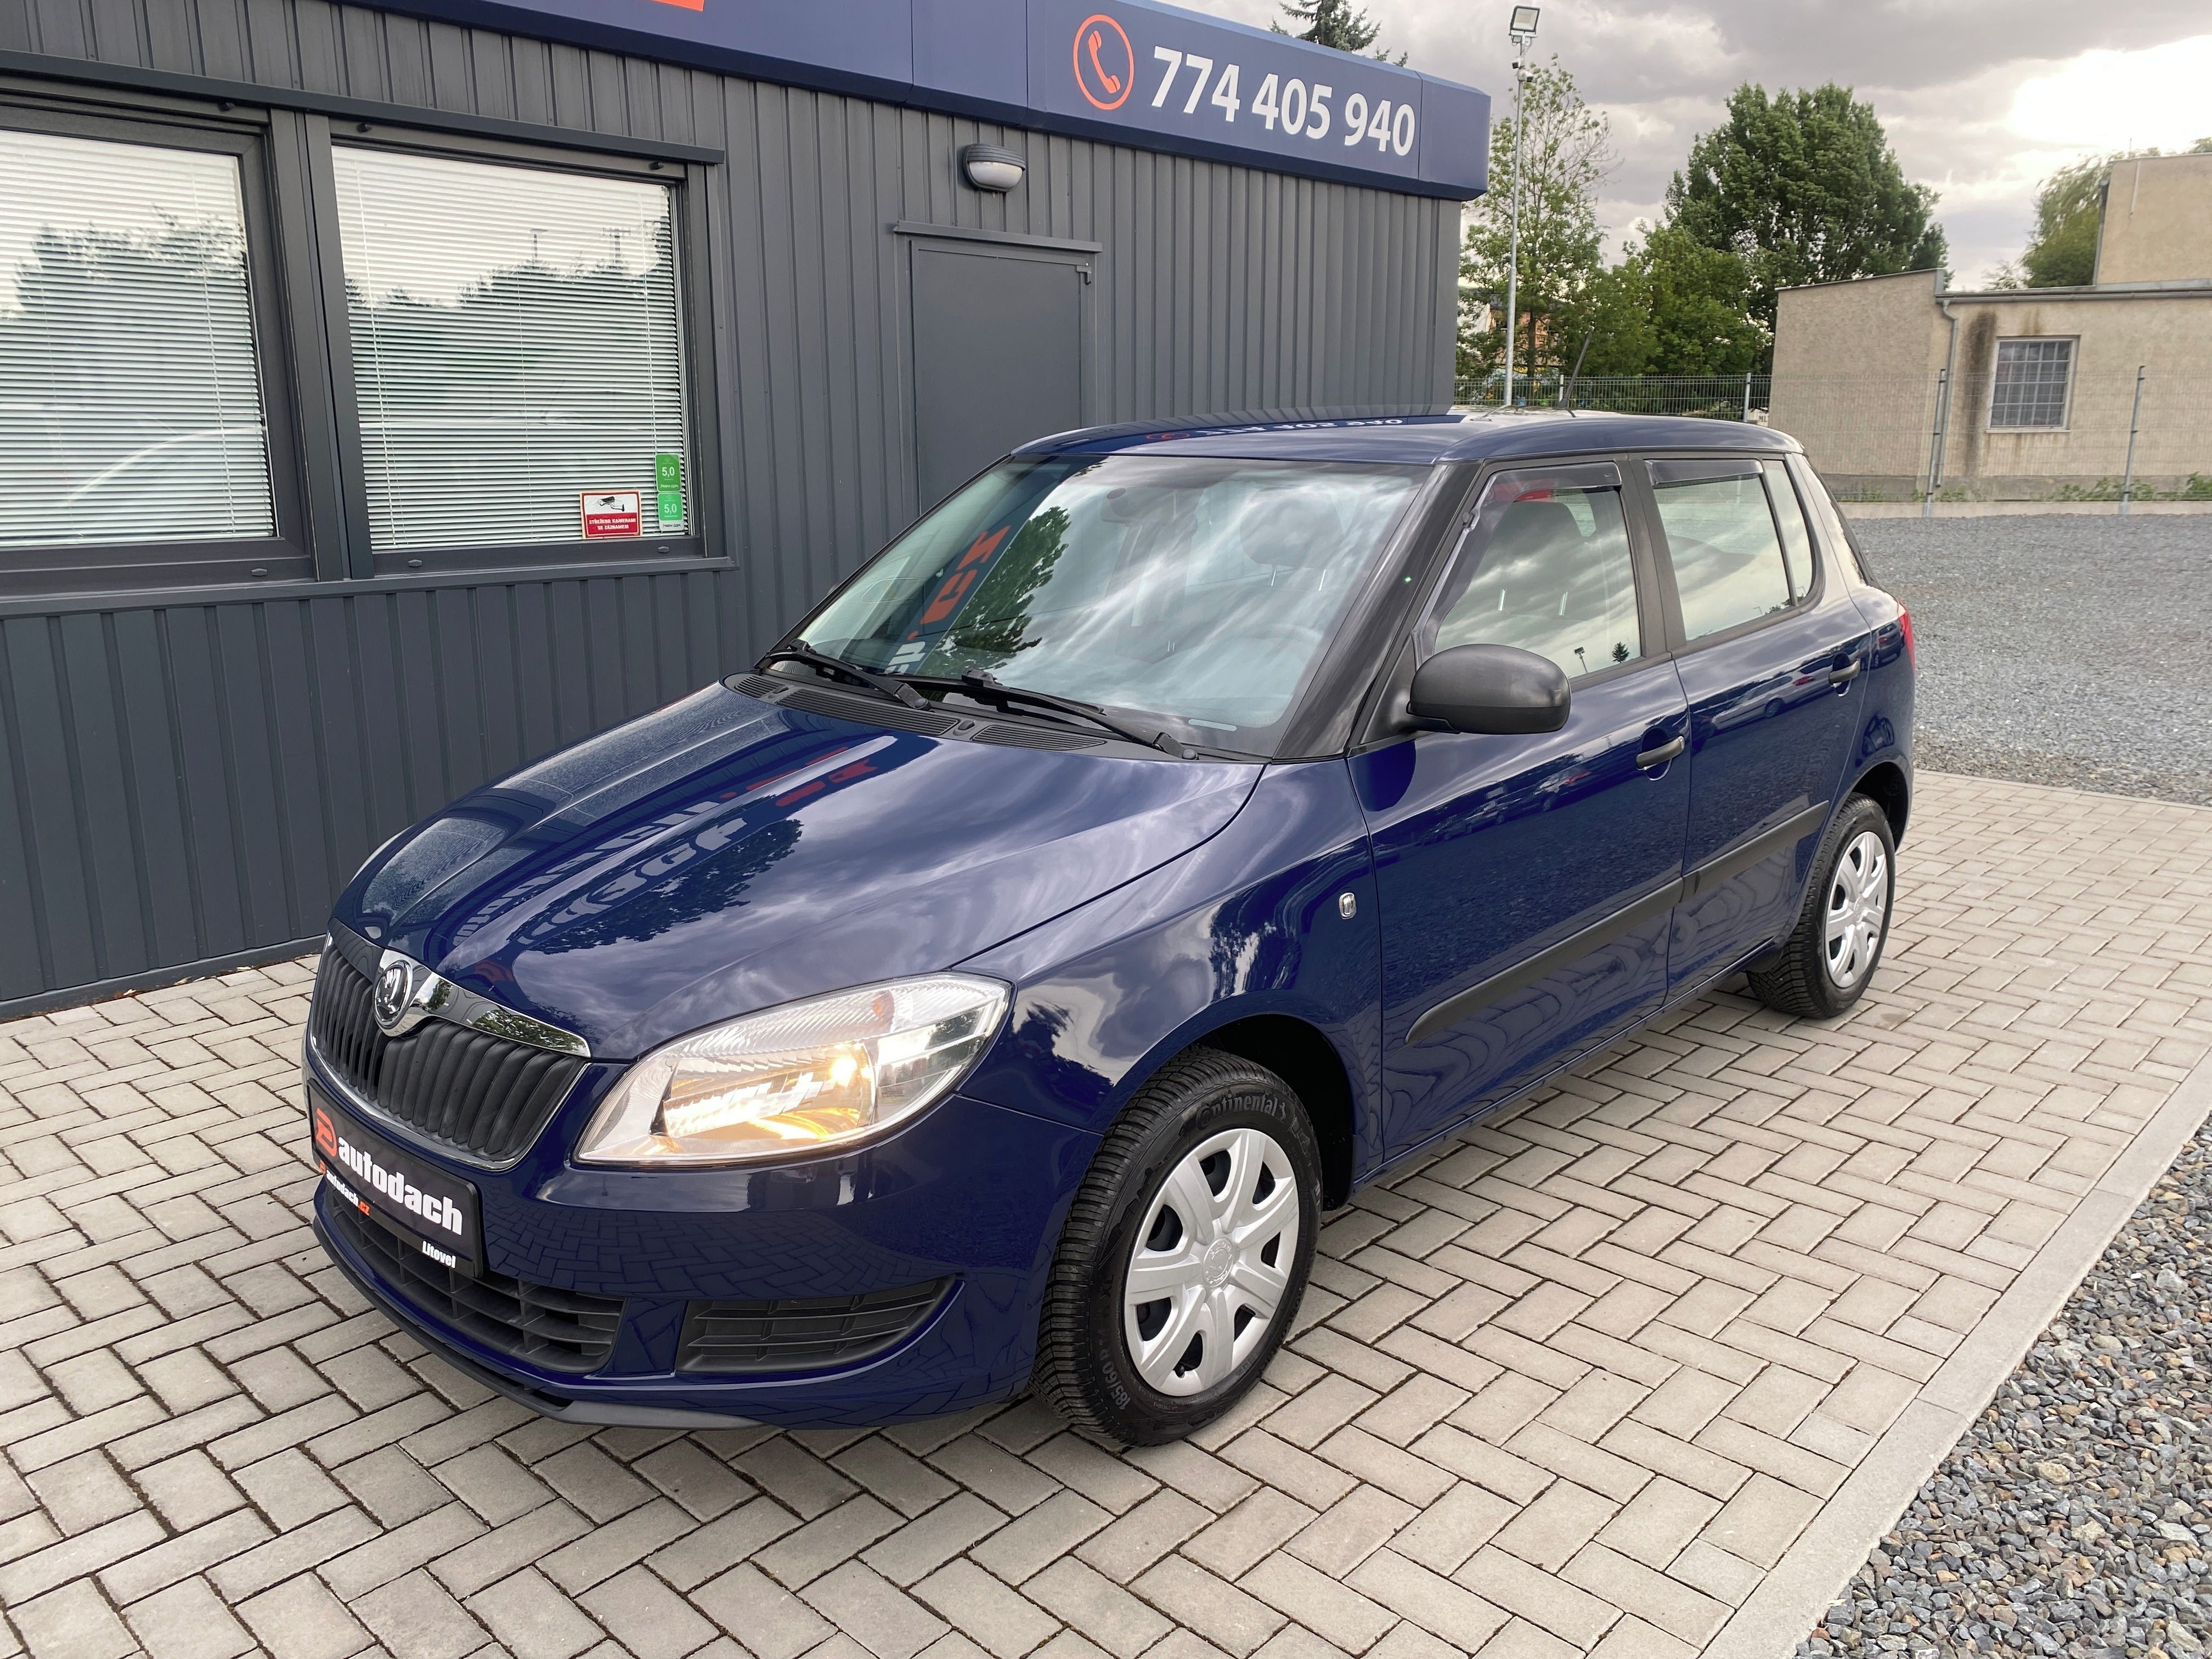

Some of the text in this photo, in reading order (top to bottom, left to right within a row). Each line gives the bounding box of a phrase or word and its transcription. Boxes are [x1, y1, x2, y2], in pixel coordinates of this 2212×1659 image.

[1152, 46, 1415, 156] 774 405 940
[662, 466, 675, 478] 5,0
[664, 503, 677, 515] 5,0
[1196, 1094, 1278, 1130] Continental
[338, 1136, 462, 1235] autodach
[422, 1240, 456, 1269] Litovel
[1102, 1359, 1130, 1410] 185/60
